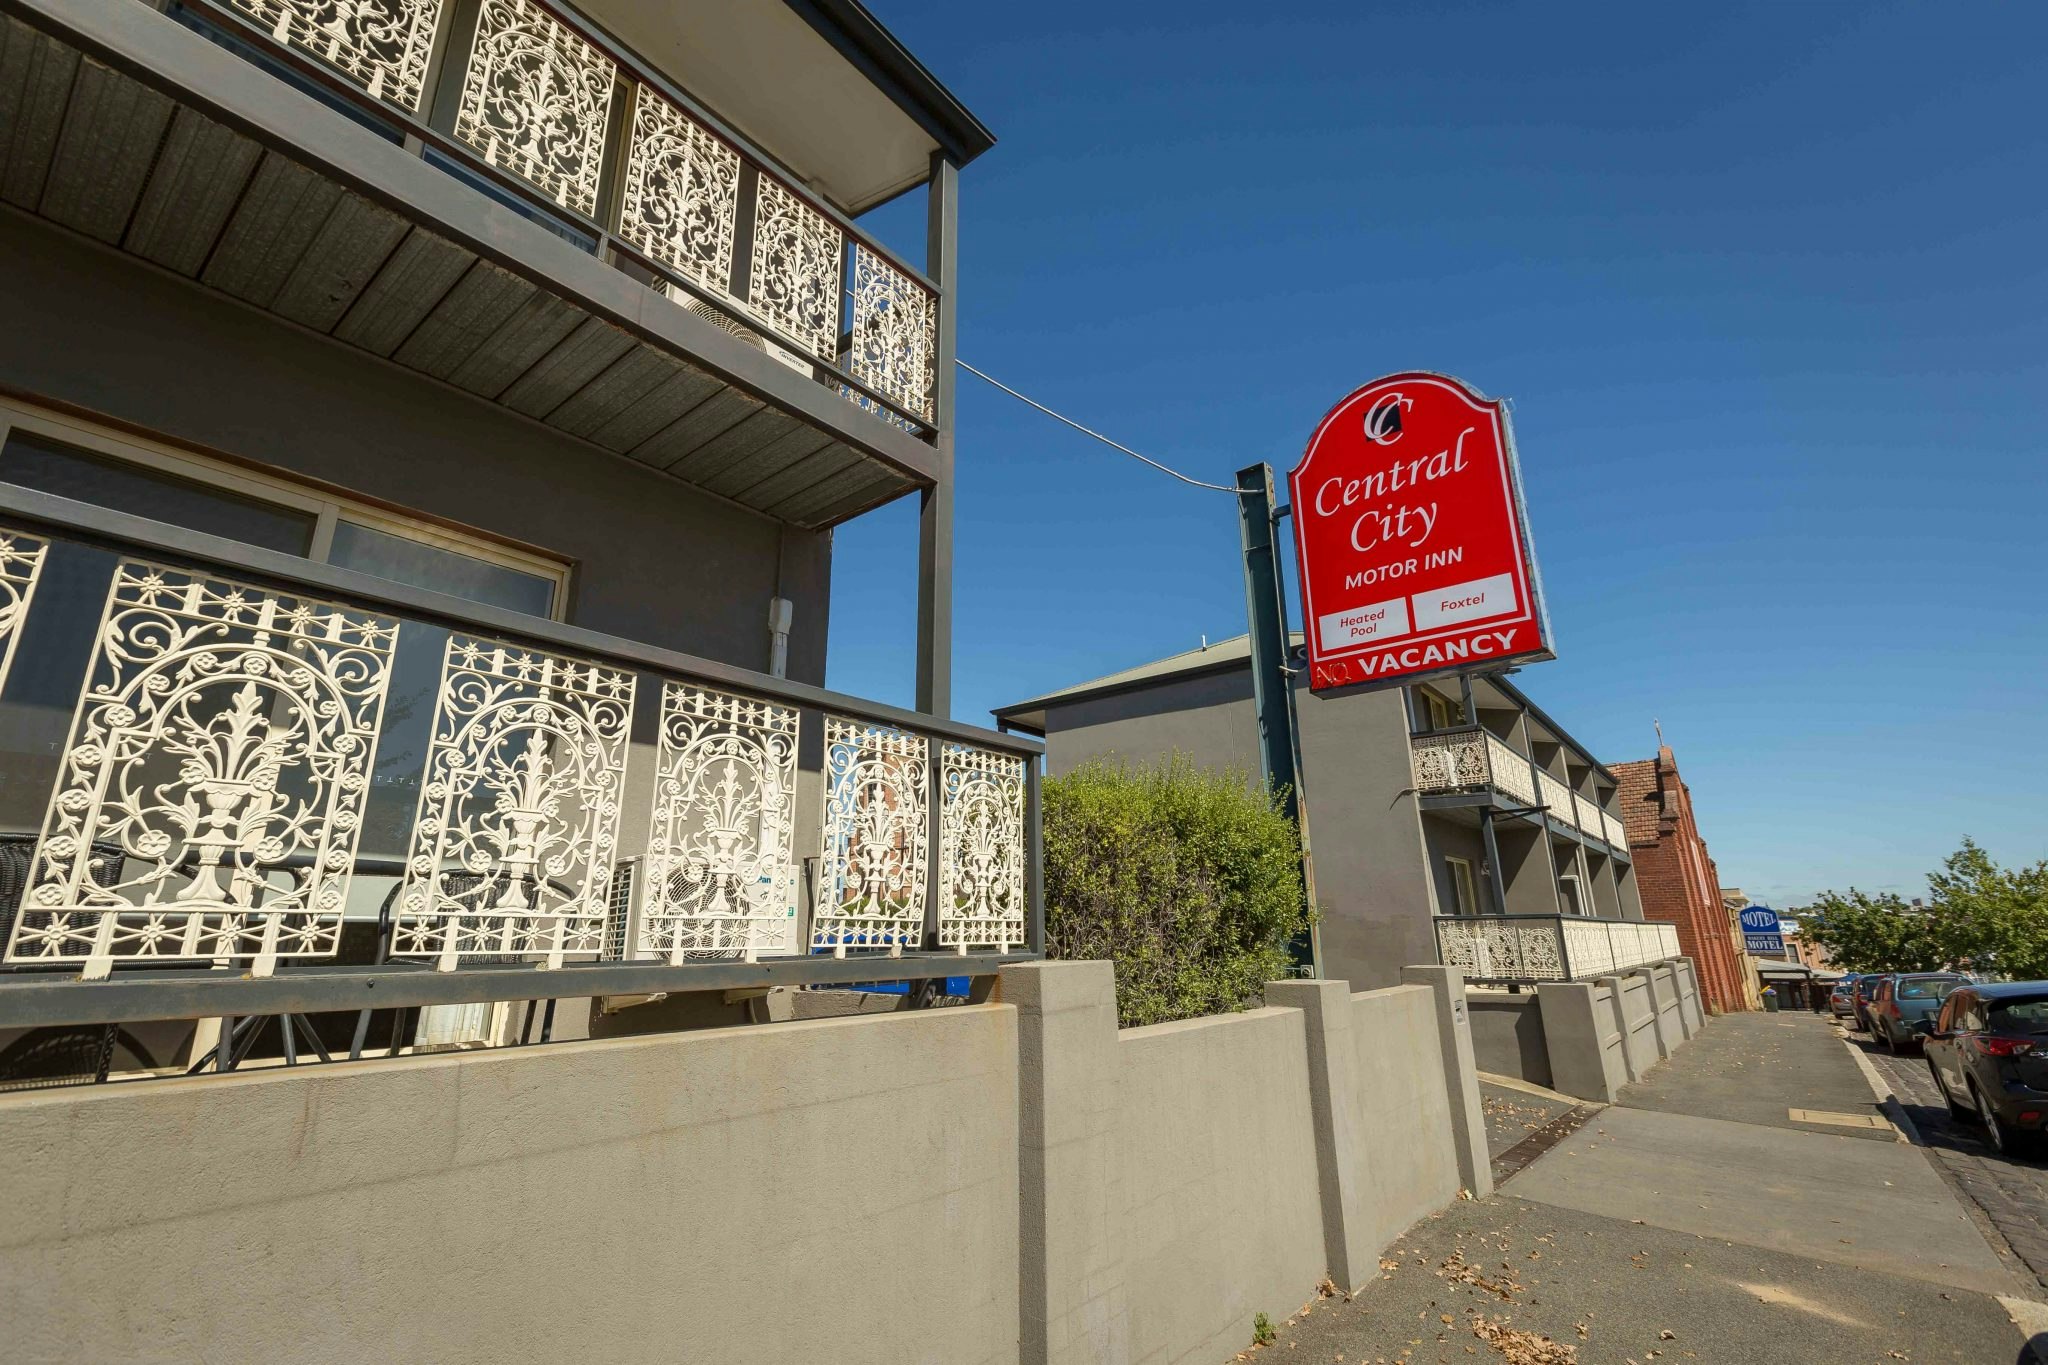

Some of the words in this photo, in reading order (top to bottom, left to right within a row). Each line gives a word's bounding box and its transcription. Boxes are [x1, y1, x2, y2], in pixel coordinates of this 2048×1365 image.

[1315, 426, 1475, 517] Central
[1350, 502, 1438, 552] City
[1344, 558, 1418, 590] MOTOR
[1424, 546, 1463, 570] INN
[1440, 592, 1485, 612] Foxtel
[1339, 608, 1385, 628] Heated
[1350, 623, 1377, 638] Pool
[1358, 628, 1518, 676] VACANCY
[1741, 911, 1776, 926] MOTEL
[1747, 940, 1783, 949] MOTEL
